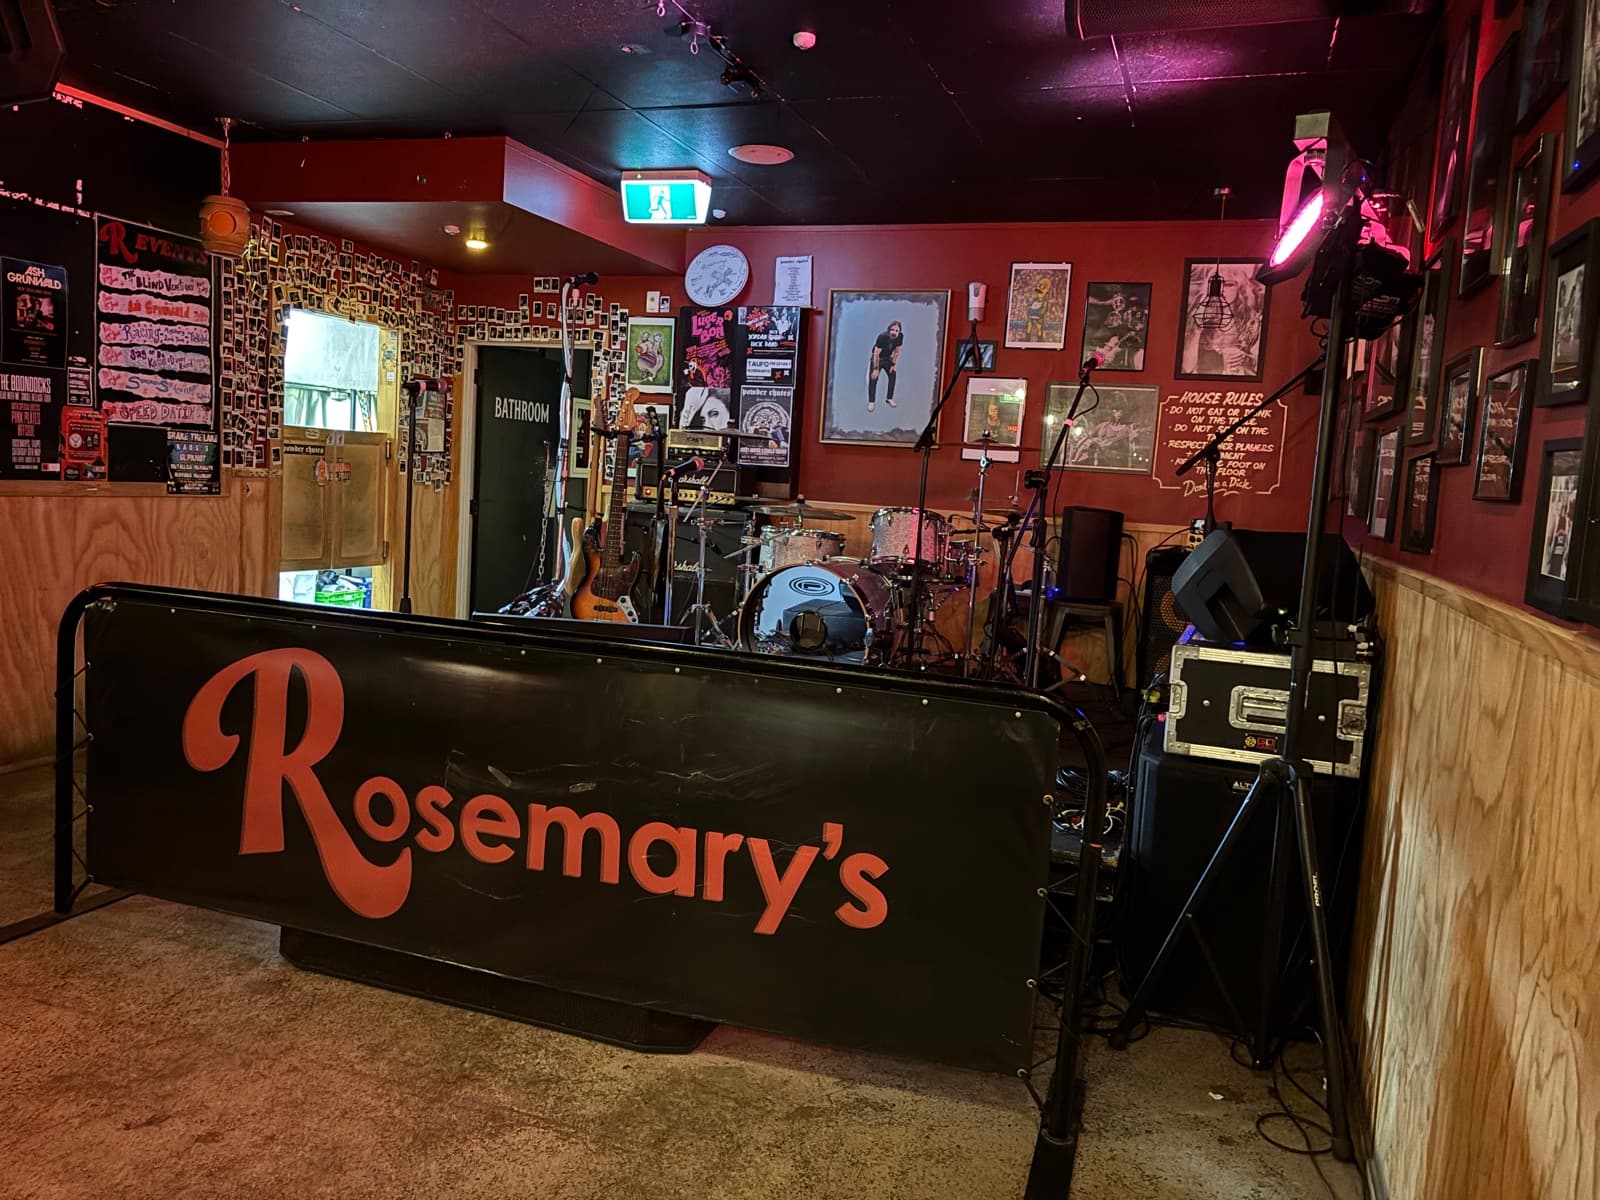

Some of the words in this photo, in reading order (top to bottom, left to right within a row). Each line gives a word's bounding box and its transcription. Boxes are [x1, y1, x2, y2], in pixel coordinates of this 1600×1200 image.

[25, 266, 45, 277] ASH
[7, 272, 62, 289] GRUNWALD
[11, 374, 51, 394] BOONDOCKS
[1179, 391, 1222, 405] HOUSE
[1222, 391, 1264, 406] RULES
[494, 396, 550, 423] BATHROOM
[1169, 406, 1183, 414] DO
[1186, 407, 1205, 415] NOT
[1207, 407, 1225, 416] EAT
[1227, 408, 1240, 416] OR
[1243, 409, 1272, 418] DINK
[1209, 416, 1226, 425] THE
[1229, 417, 1257, 426] TALE
[1192, 425, 1213, 433] NOT
[1235, 426, 1250, 434] ON
[1250, 427, 1269, 436] THE
[1168, 439, 1208, 449] RESPECT
[1234, 442, 1274, 452] PLAYERS
[1226, 461, 1252, 469] FOOT
[1252, 462, 1266, 470] ON
[1215, 468, 1246, 476] FLOOR
[1229, 477, 1252, 490] Dick
[182, 647, 890, 934] Rosemary's
[1232, 780, 1254, 790] ALT
